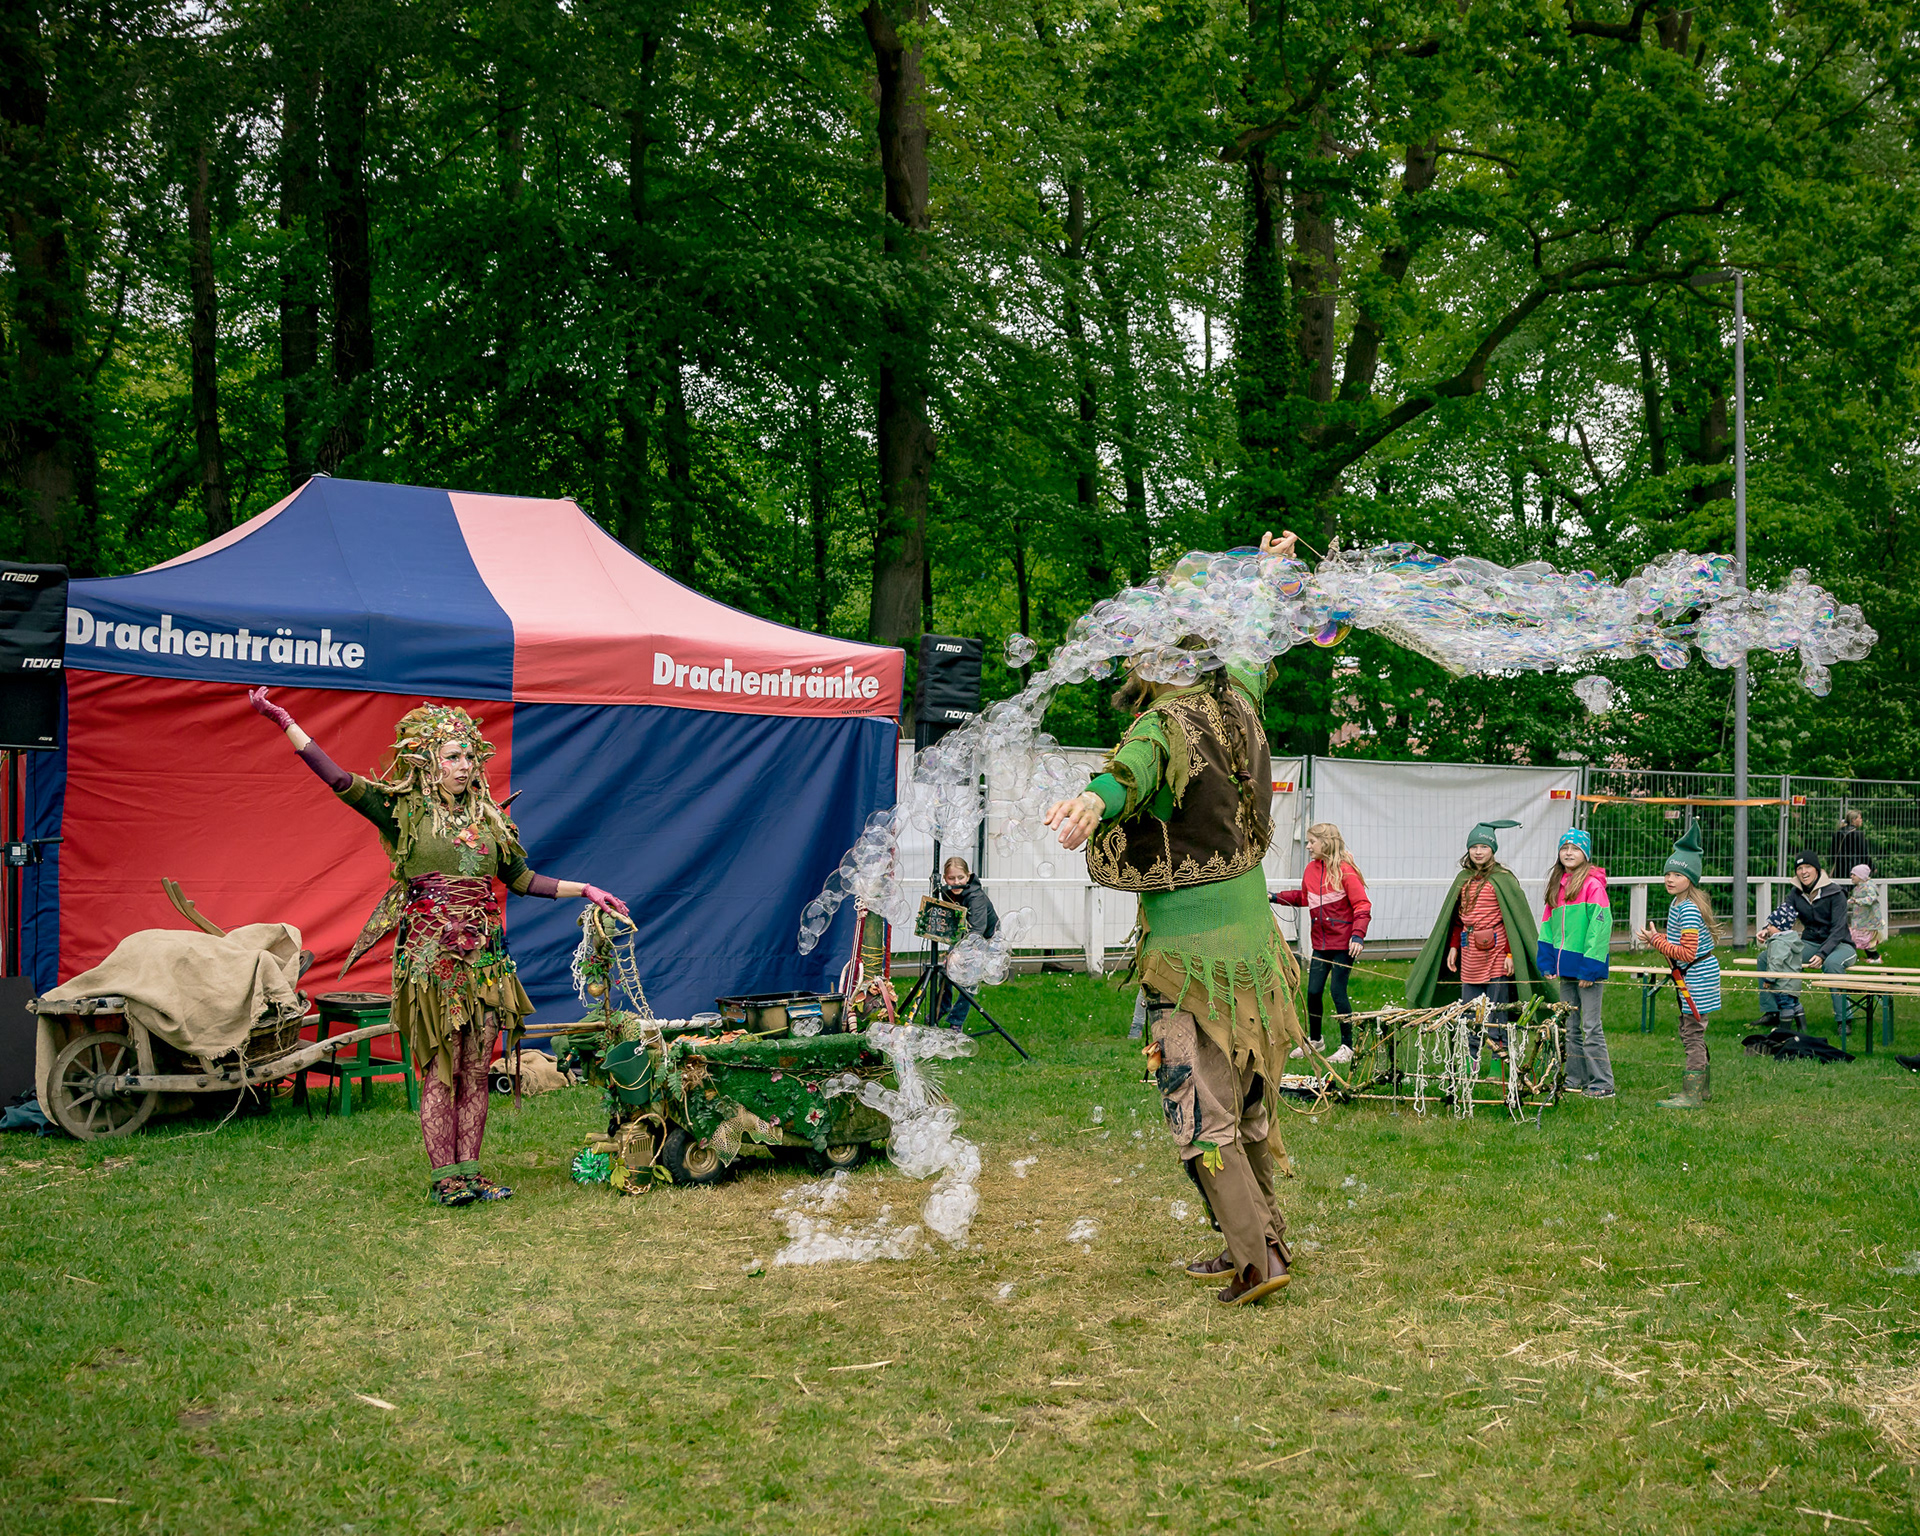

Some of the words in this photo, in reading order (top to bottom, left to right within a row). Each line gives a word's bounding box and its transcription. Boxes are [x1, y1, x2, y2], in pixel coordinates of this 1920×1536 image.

[65, 606, 365, 669] Drachentränke
[652, 652, 880, 699] Drachentränke
[1669, 859, 1688, 869] Cloudy
